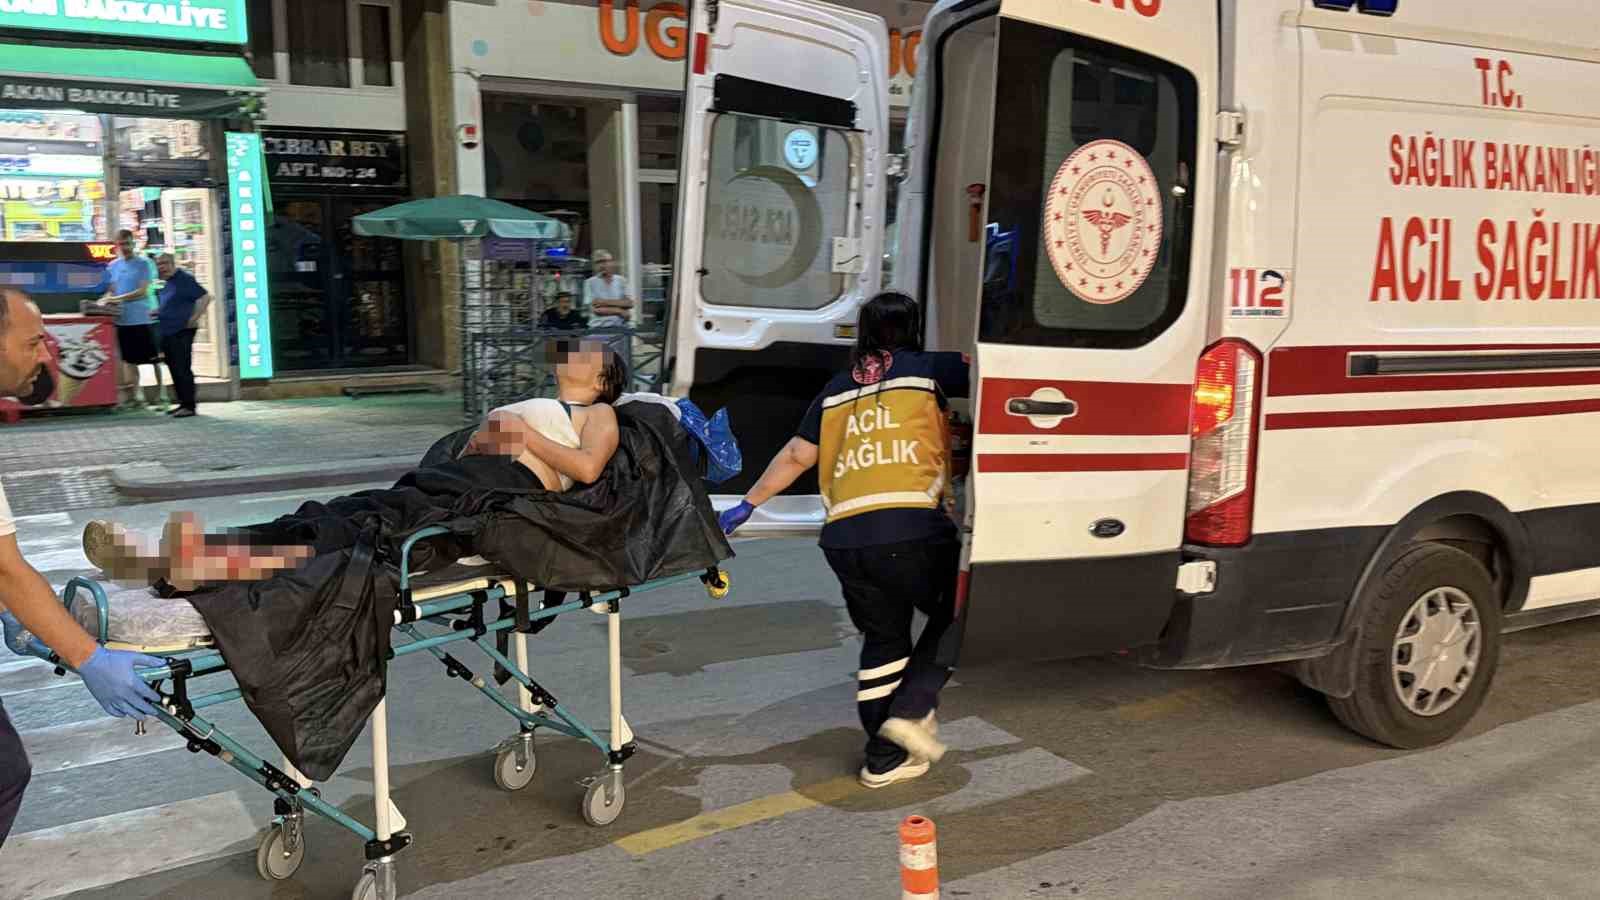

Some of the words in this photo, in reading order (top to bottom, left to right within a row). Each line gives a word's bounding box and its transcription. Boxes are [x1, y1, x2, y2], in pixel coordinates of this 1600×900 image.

[2, 84, 64, 100] AKAN
[67, 89, 180, 108] BAKKALİYE
[1474, 58, 1523, 108] T.C.
[351, 141, 388, 157] BEY
[1389, 131, 1477, 188] SAĞLIK
[1474, 208, 1600, 301] SAĞLIK
[1231, 269, 1284, 307] 112
[834, 438, 920, 478] SAĞLIK
